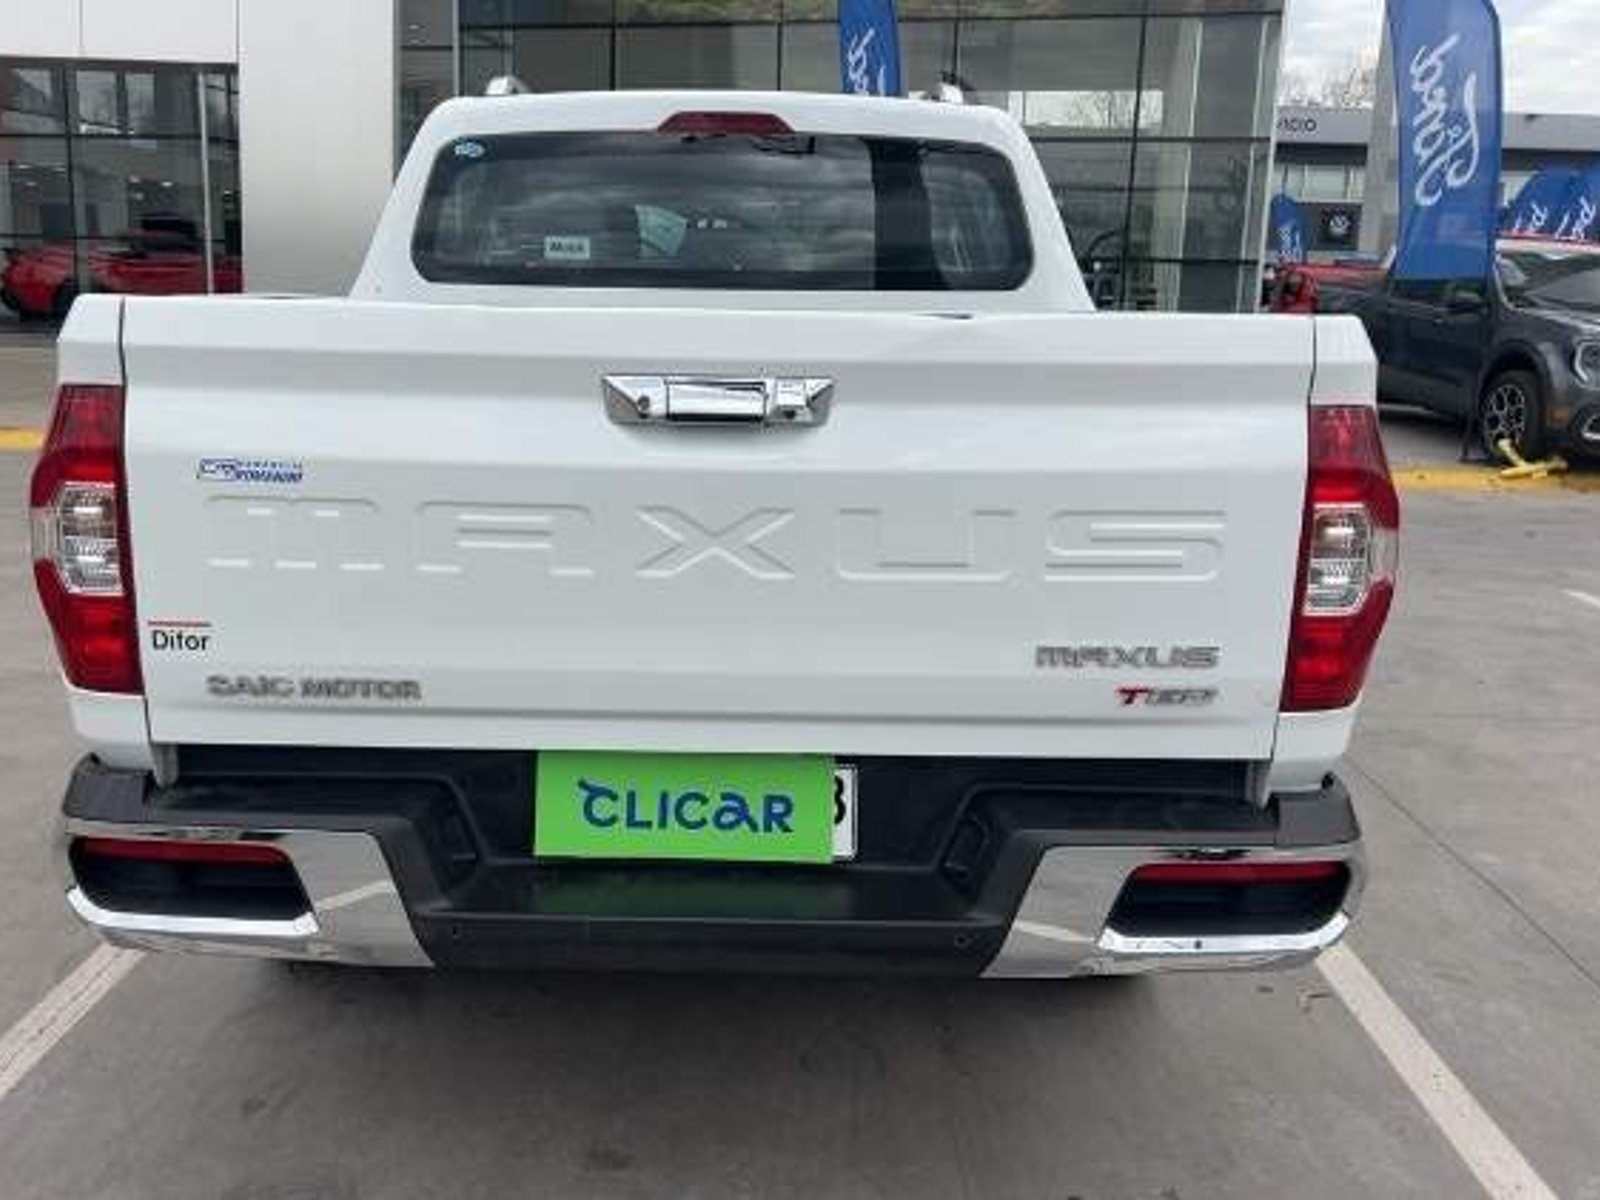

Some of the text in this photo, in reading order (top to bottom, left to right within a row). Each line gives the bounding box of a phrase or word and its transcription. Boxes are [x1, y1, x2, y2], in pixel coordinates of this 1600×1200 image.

[206, 493, 1227, 583] MAXUS
[1035, 645, 1221, 669] MAXUS
[206, 674, 422, 700] SAIC MOTOR
